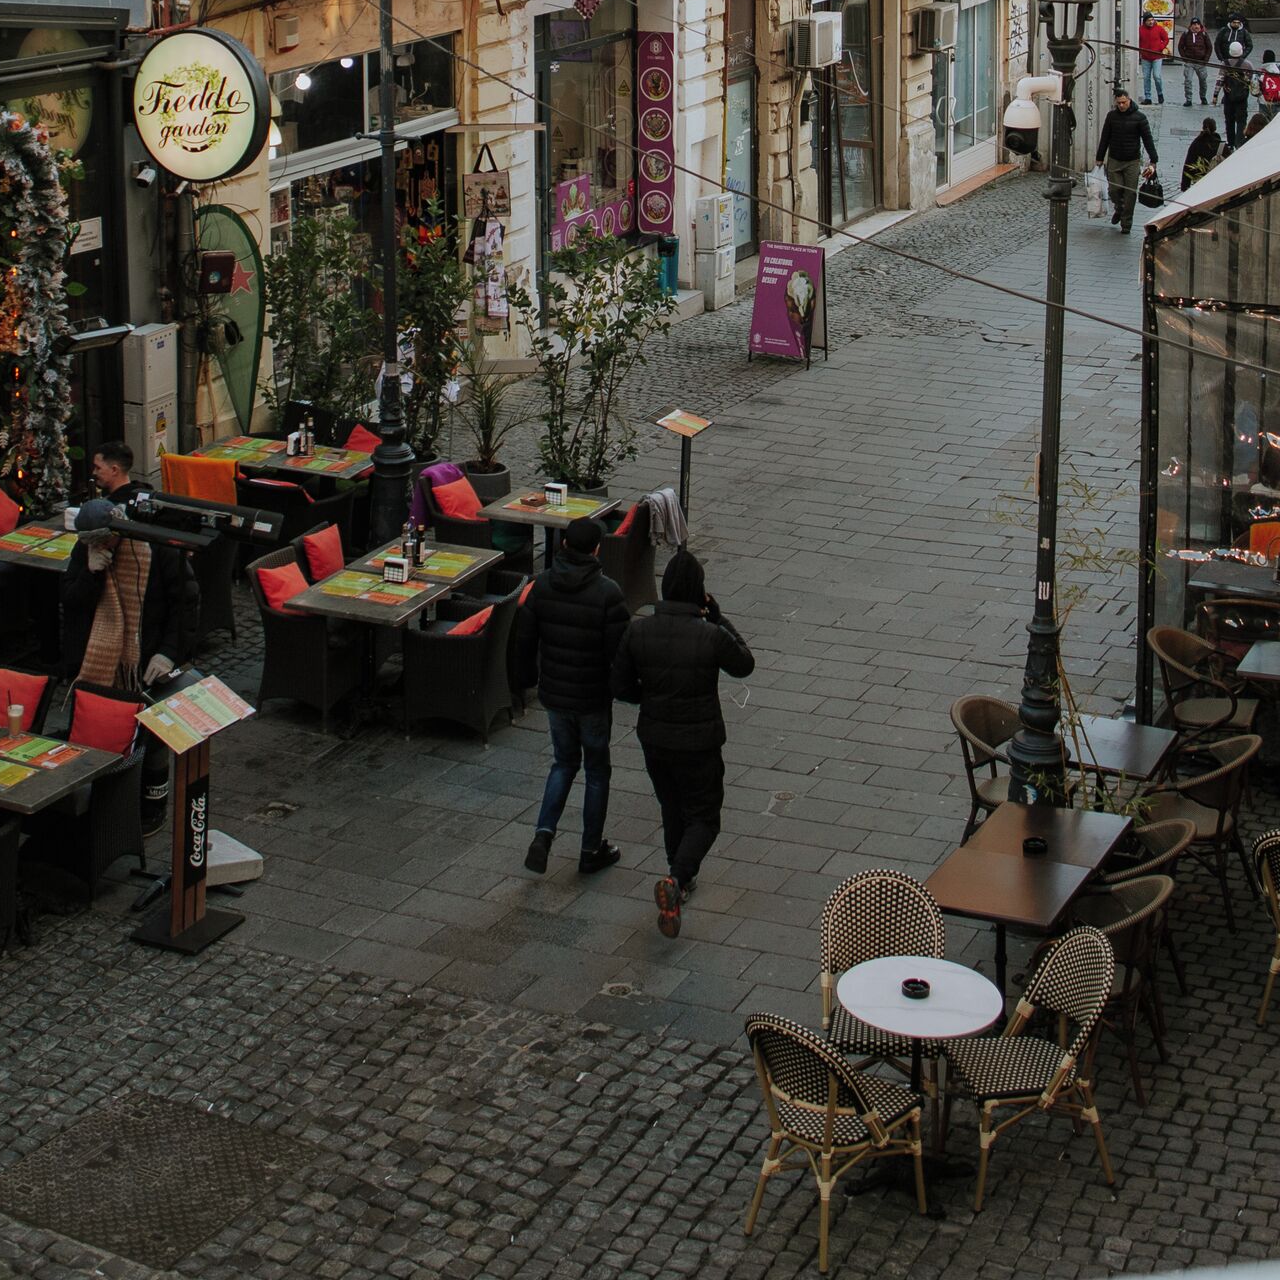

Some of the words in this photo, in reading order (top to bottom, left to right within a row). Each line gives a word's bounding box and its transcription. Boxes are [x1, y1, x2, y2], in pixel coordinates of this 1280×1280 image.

[138, 76, 250, 117] Freddo
[158, 116, 229, 149] garden
[189, 792, 207, 867] Coca-Cola
